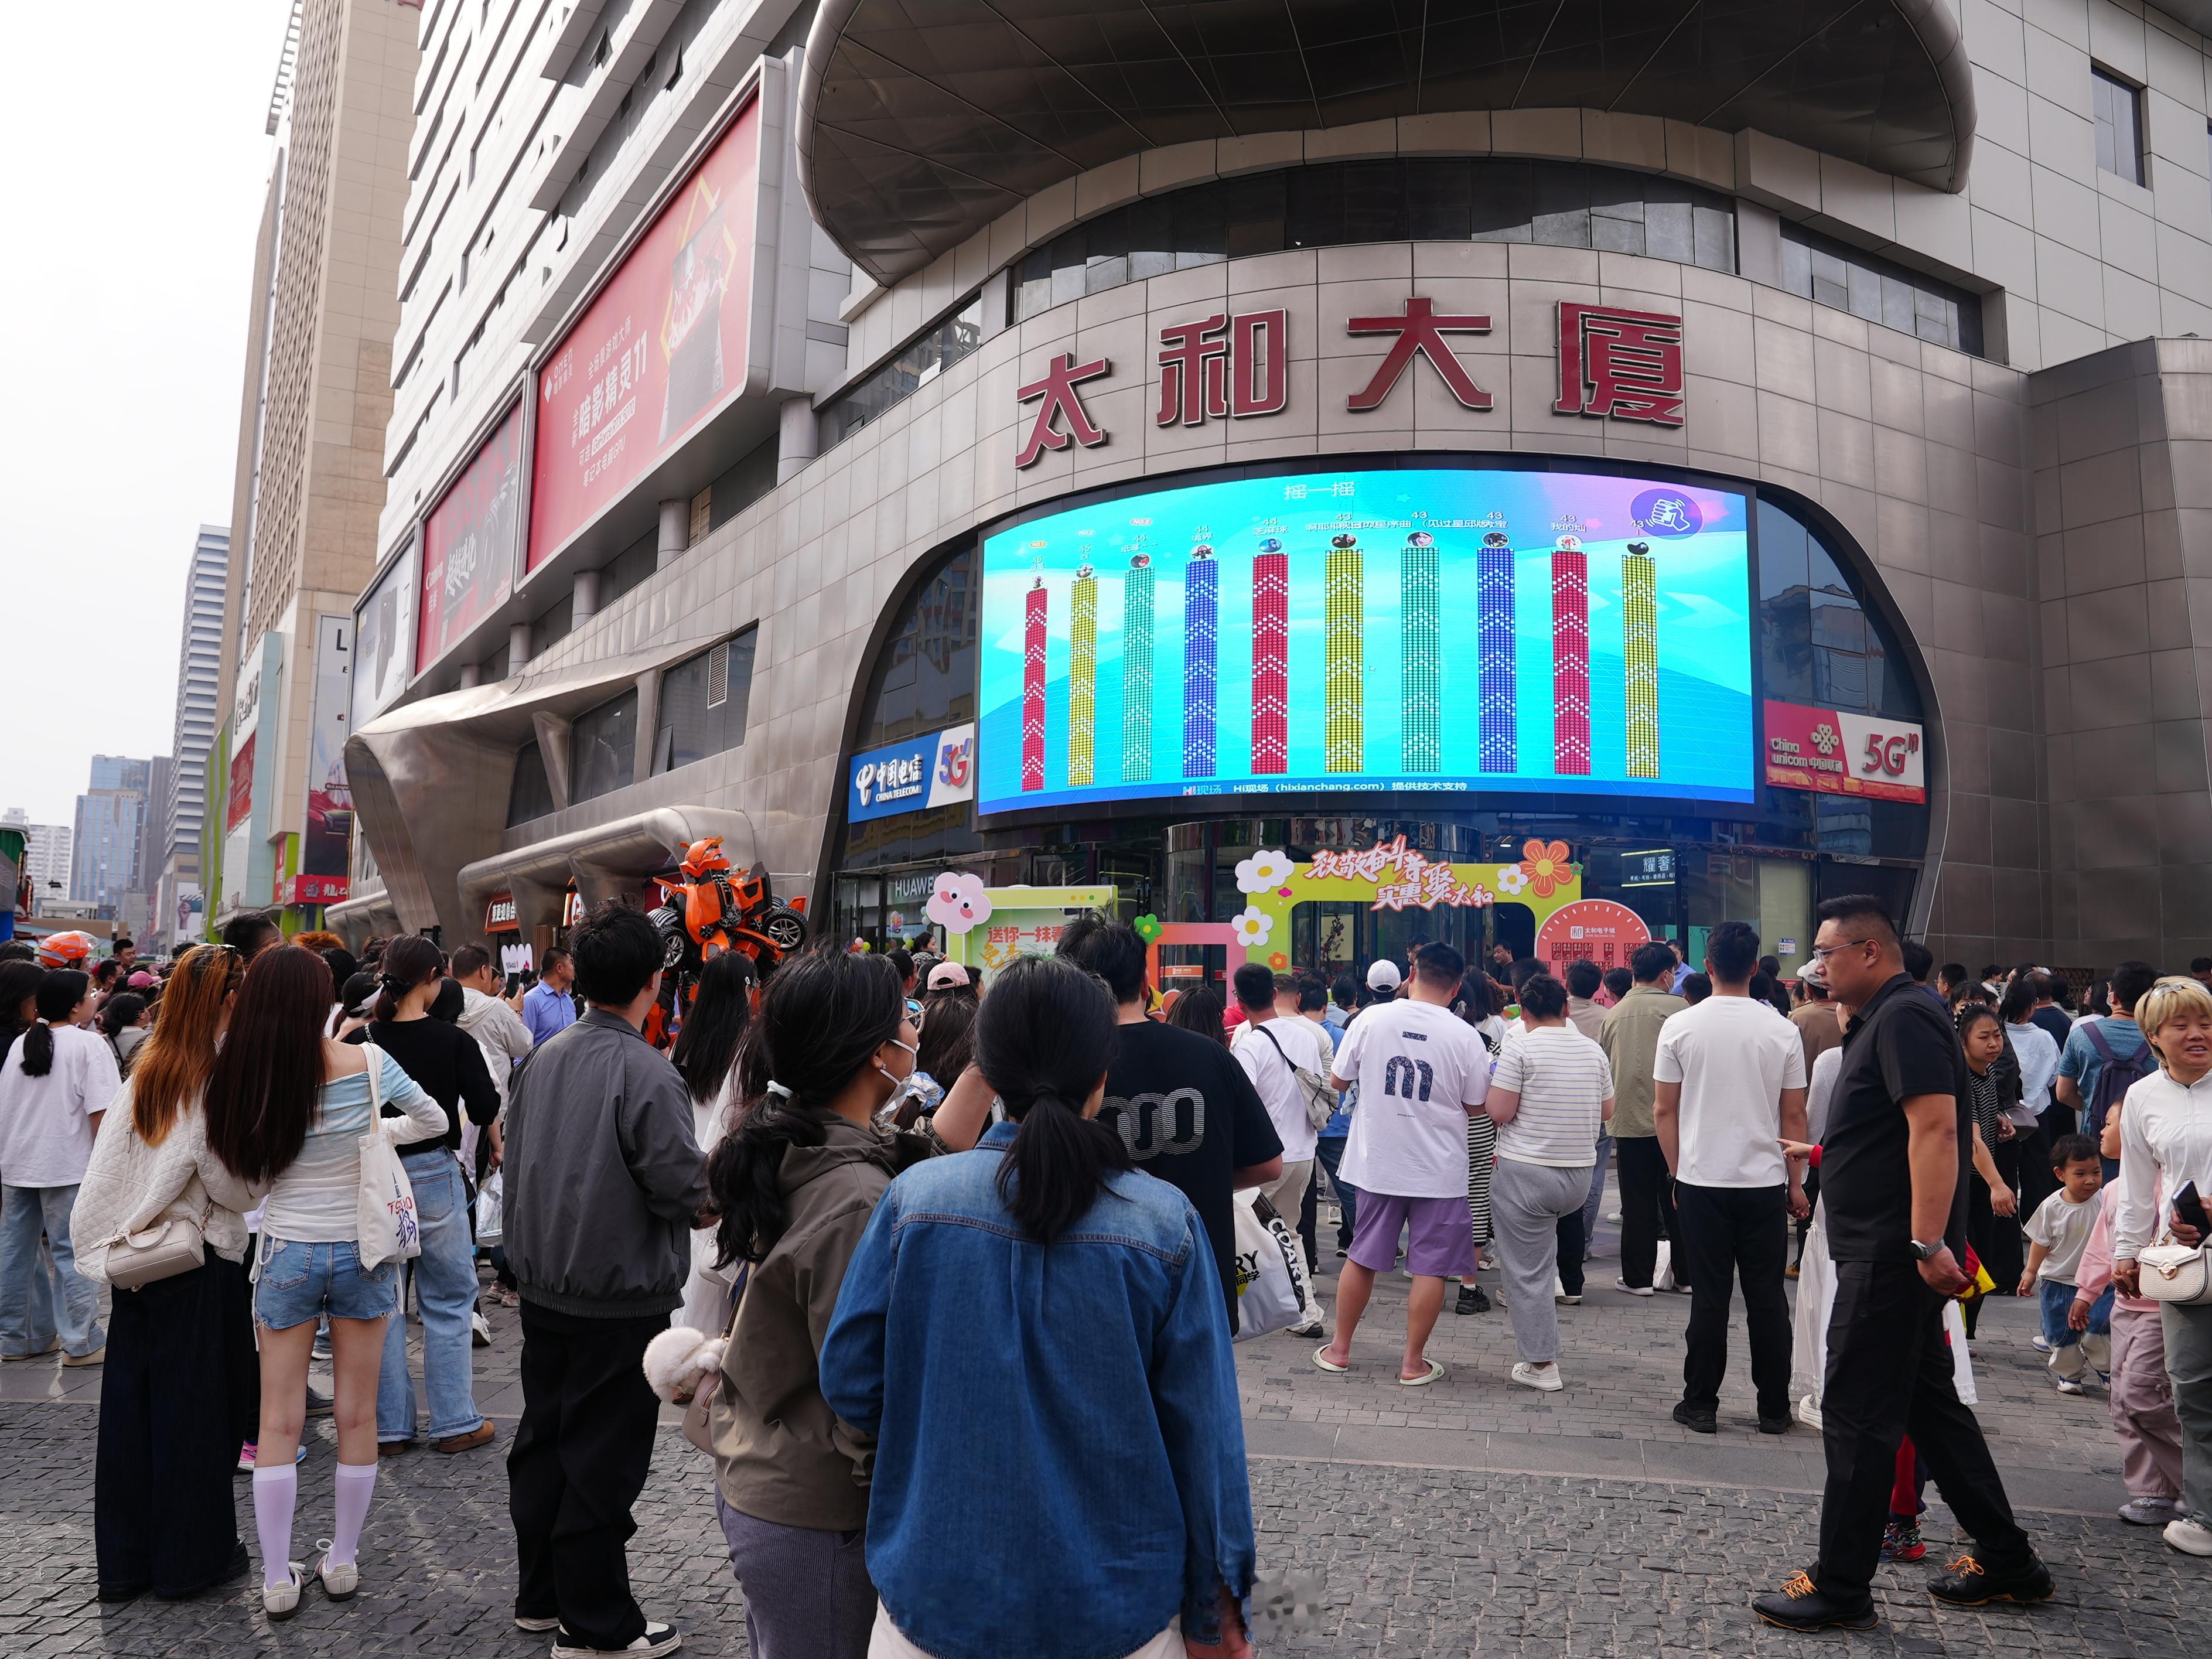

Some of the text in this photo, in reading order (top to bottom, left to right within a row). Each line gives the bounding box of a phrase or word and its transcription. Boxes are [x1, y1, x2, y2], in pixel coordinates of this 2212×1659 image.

[579, 330, 647, 439] 暗影精灵11
[1015, 298, 1685, 470] 太和大厦
[1283, 481, 1356, 500] 摇一摇
[1487, 511, 1503, 520] 43
[1561, 514, 1576, 523] 43
[1770, 738, 1800, 753] China
[1771, 753, 1808, 767] unicom
[1808, 756, 1843, 772] 中国联通
[877, 753, 923, 792] 中国电信
[876, 785, 922, 802] CHINA TELECOM
[1305, 834, 1429, 882] 致敬奋斗者
[895, 875, 937, 897] HUAWE
[1370, 861, 1494, 912] 实惠聚太和
